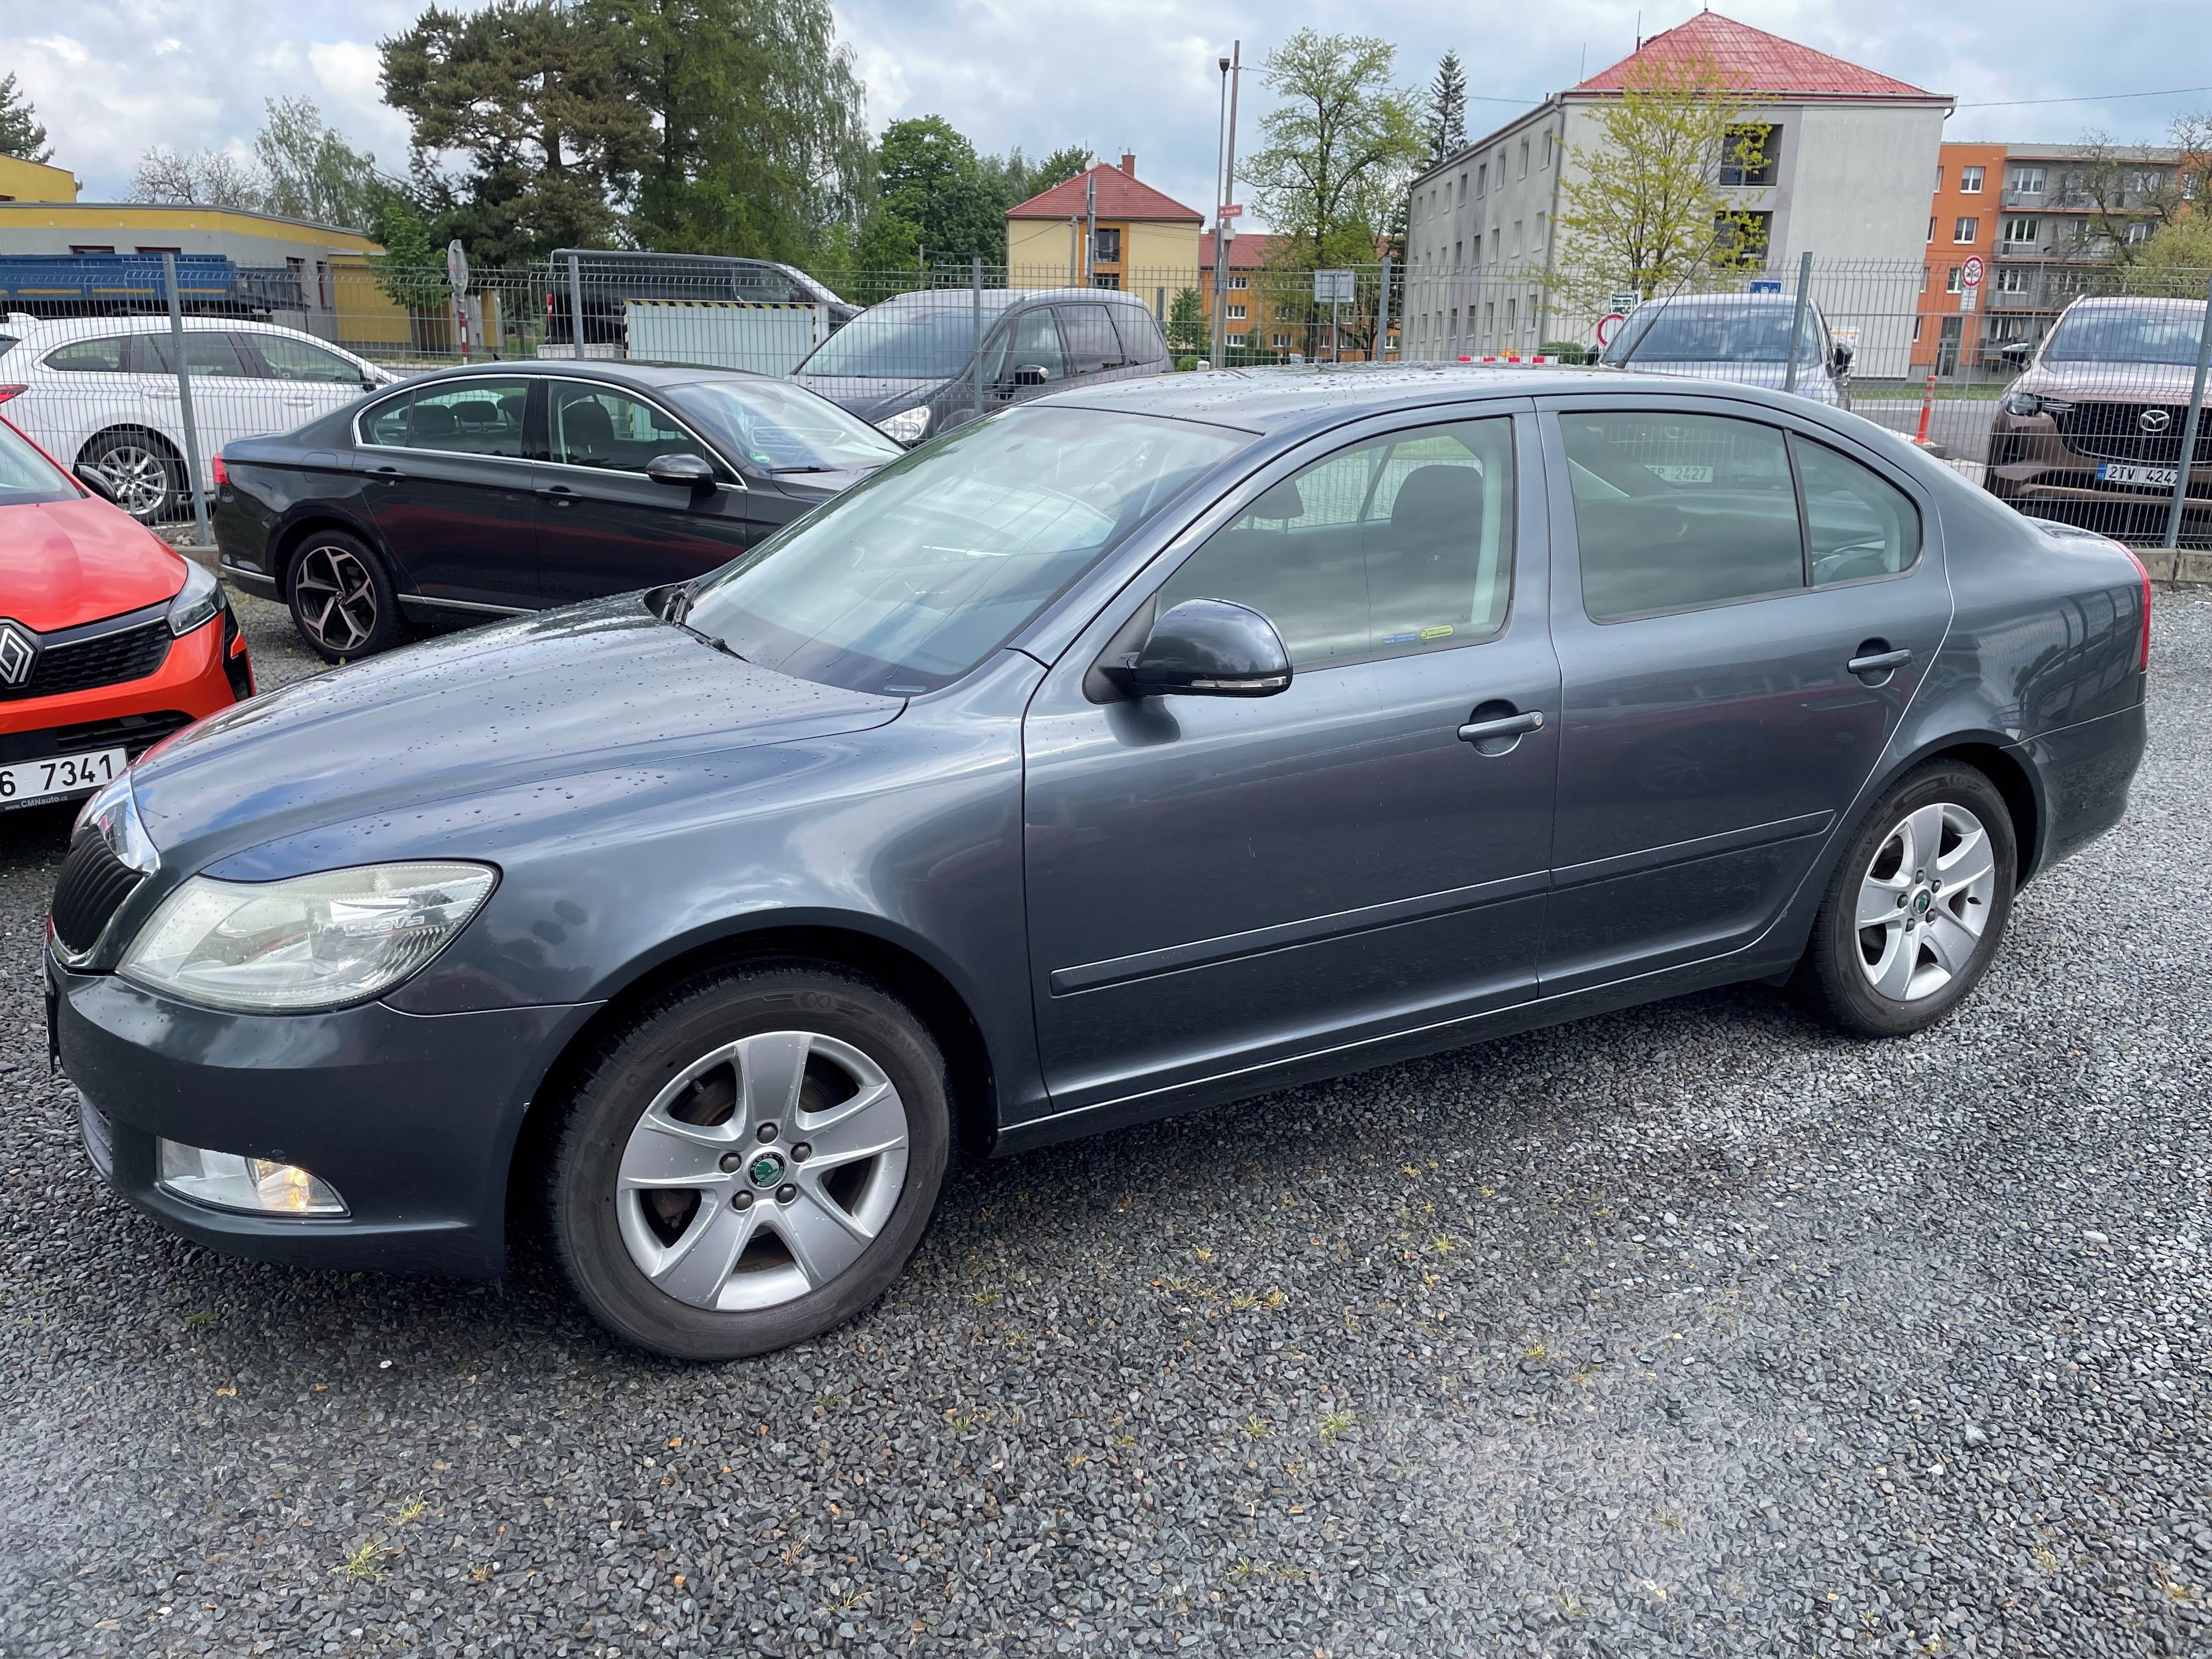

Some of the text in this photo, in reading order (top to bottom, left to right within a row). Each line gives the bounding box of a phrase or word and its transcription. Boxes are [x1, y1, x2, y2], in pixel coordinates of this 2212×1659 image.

[1674, 467, 1707, 480] 2427
[2109, 466, 2135, 480] 2TV
[40, 754, 112, 791] 7341
[4, 795, 68, 811] www.CMNauto.cz
